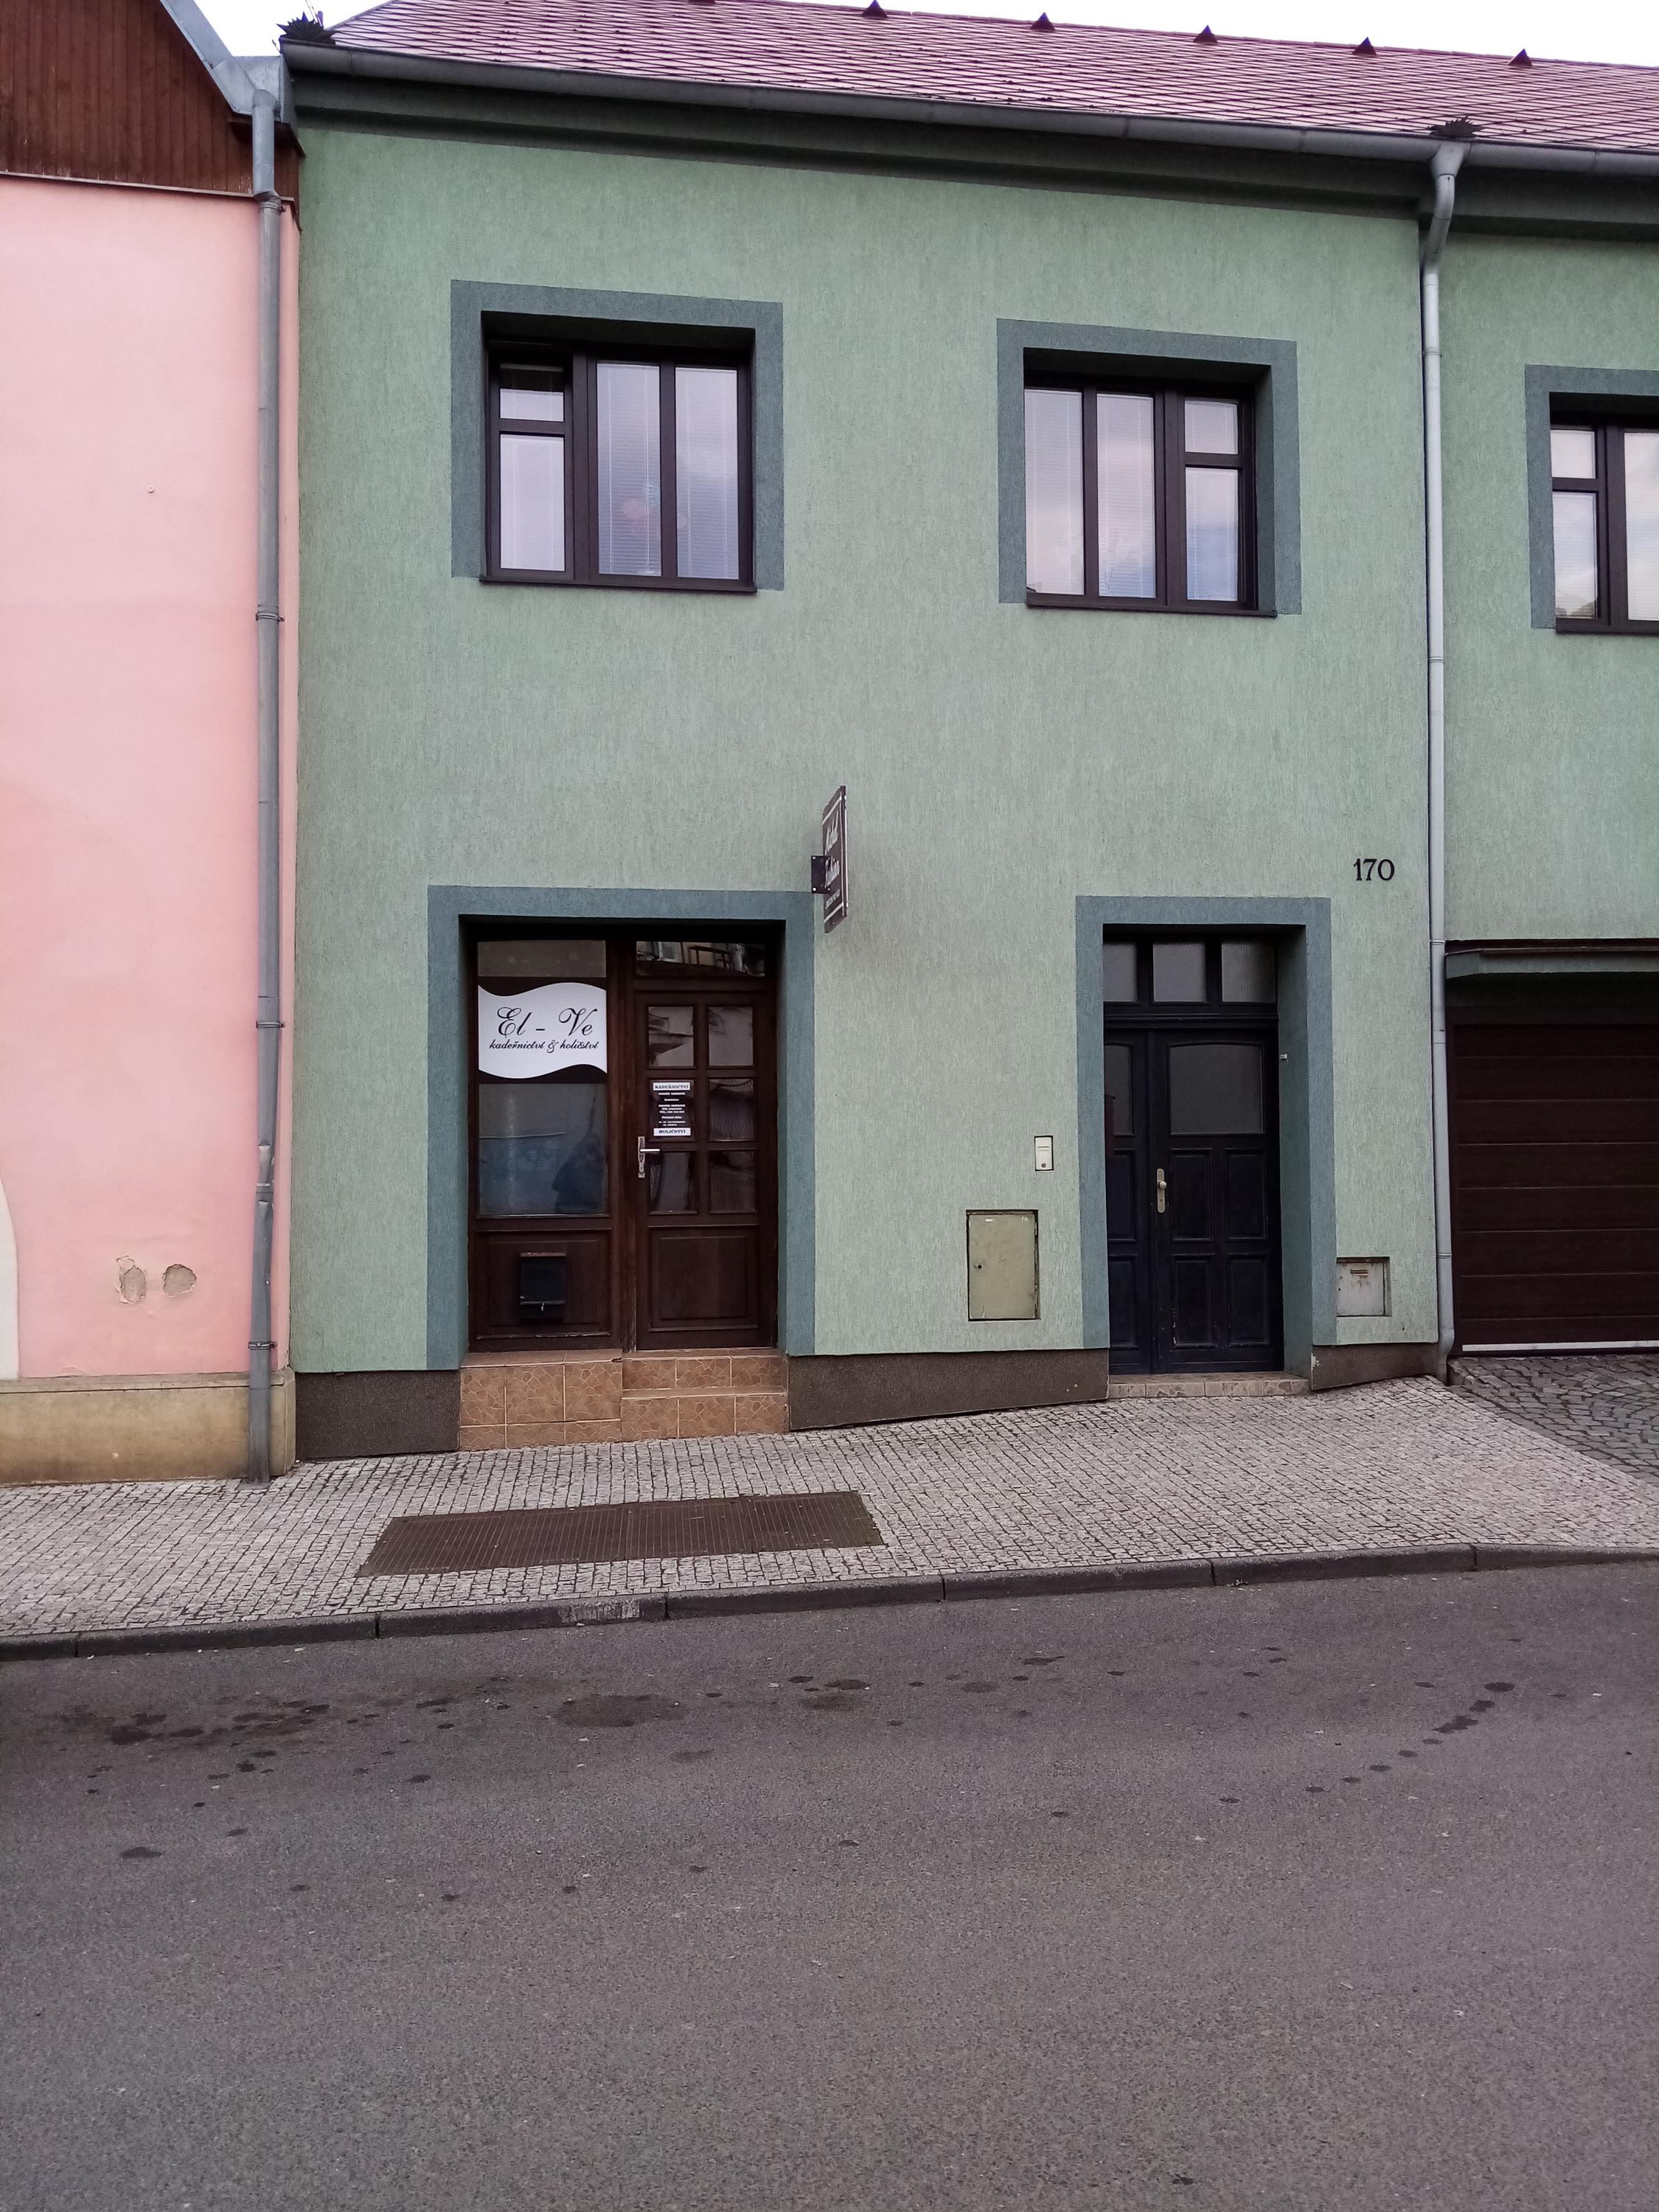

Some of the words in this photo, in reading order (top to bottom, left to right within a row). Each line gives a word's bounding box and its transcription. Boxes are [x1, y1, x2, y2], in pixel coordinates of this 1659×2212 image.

[1353, 858, 1395, 881] 170
[497, 1006, 532, 1038] El
[558, 1007, 598, 1036] Ve
[546, 1039, 559, 1054] &
